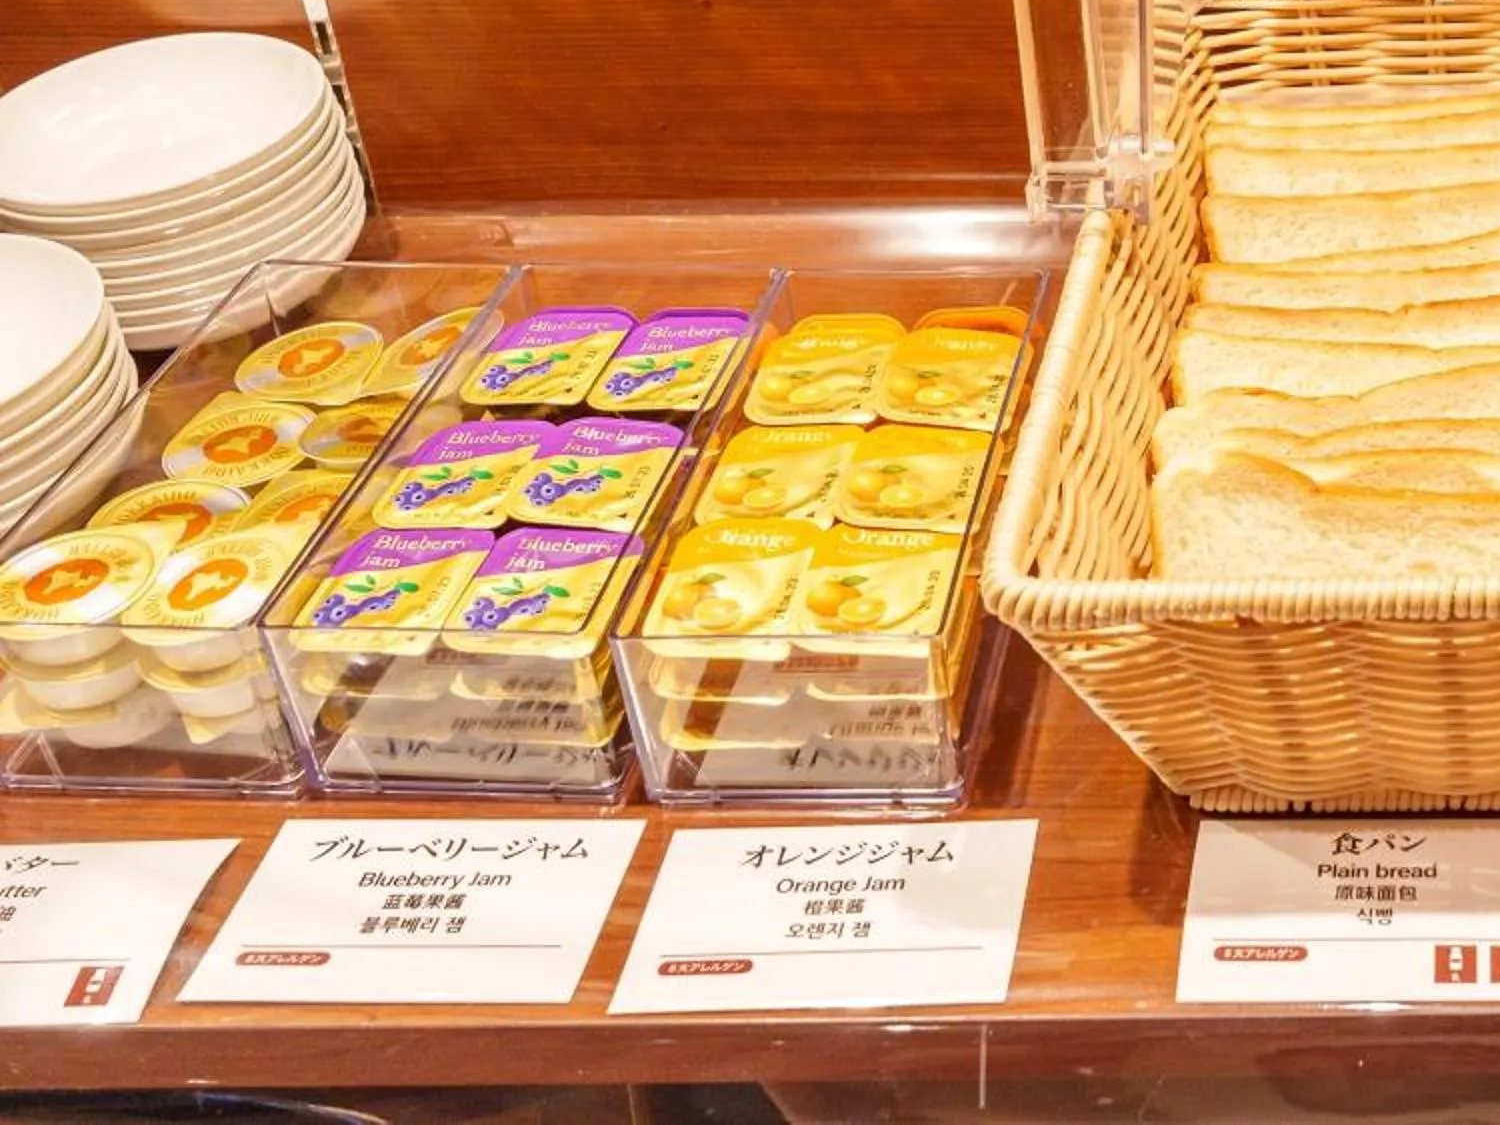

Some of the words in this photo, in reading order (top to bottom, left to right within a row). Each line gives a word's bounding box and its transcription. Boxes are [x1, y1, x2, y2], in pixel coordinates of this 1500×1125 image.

[373, 533, 470, 552] Blueberry
[309, 836, 589, 861] ブルーベリージャム
[1331, 832, 1428, 856] 食パン
[741, 841, 954, 868] オレンジジャム
[1317, 862, 1370, 878] Plain
[1375, 862, 1438, 878] bread
[358, 871, 465, 890] Blueberry
[467, 871, 512, 887] Jam
[776, 877, 857, 896] Orange
[861, 876, 905, 891] Jam
